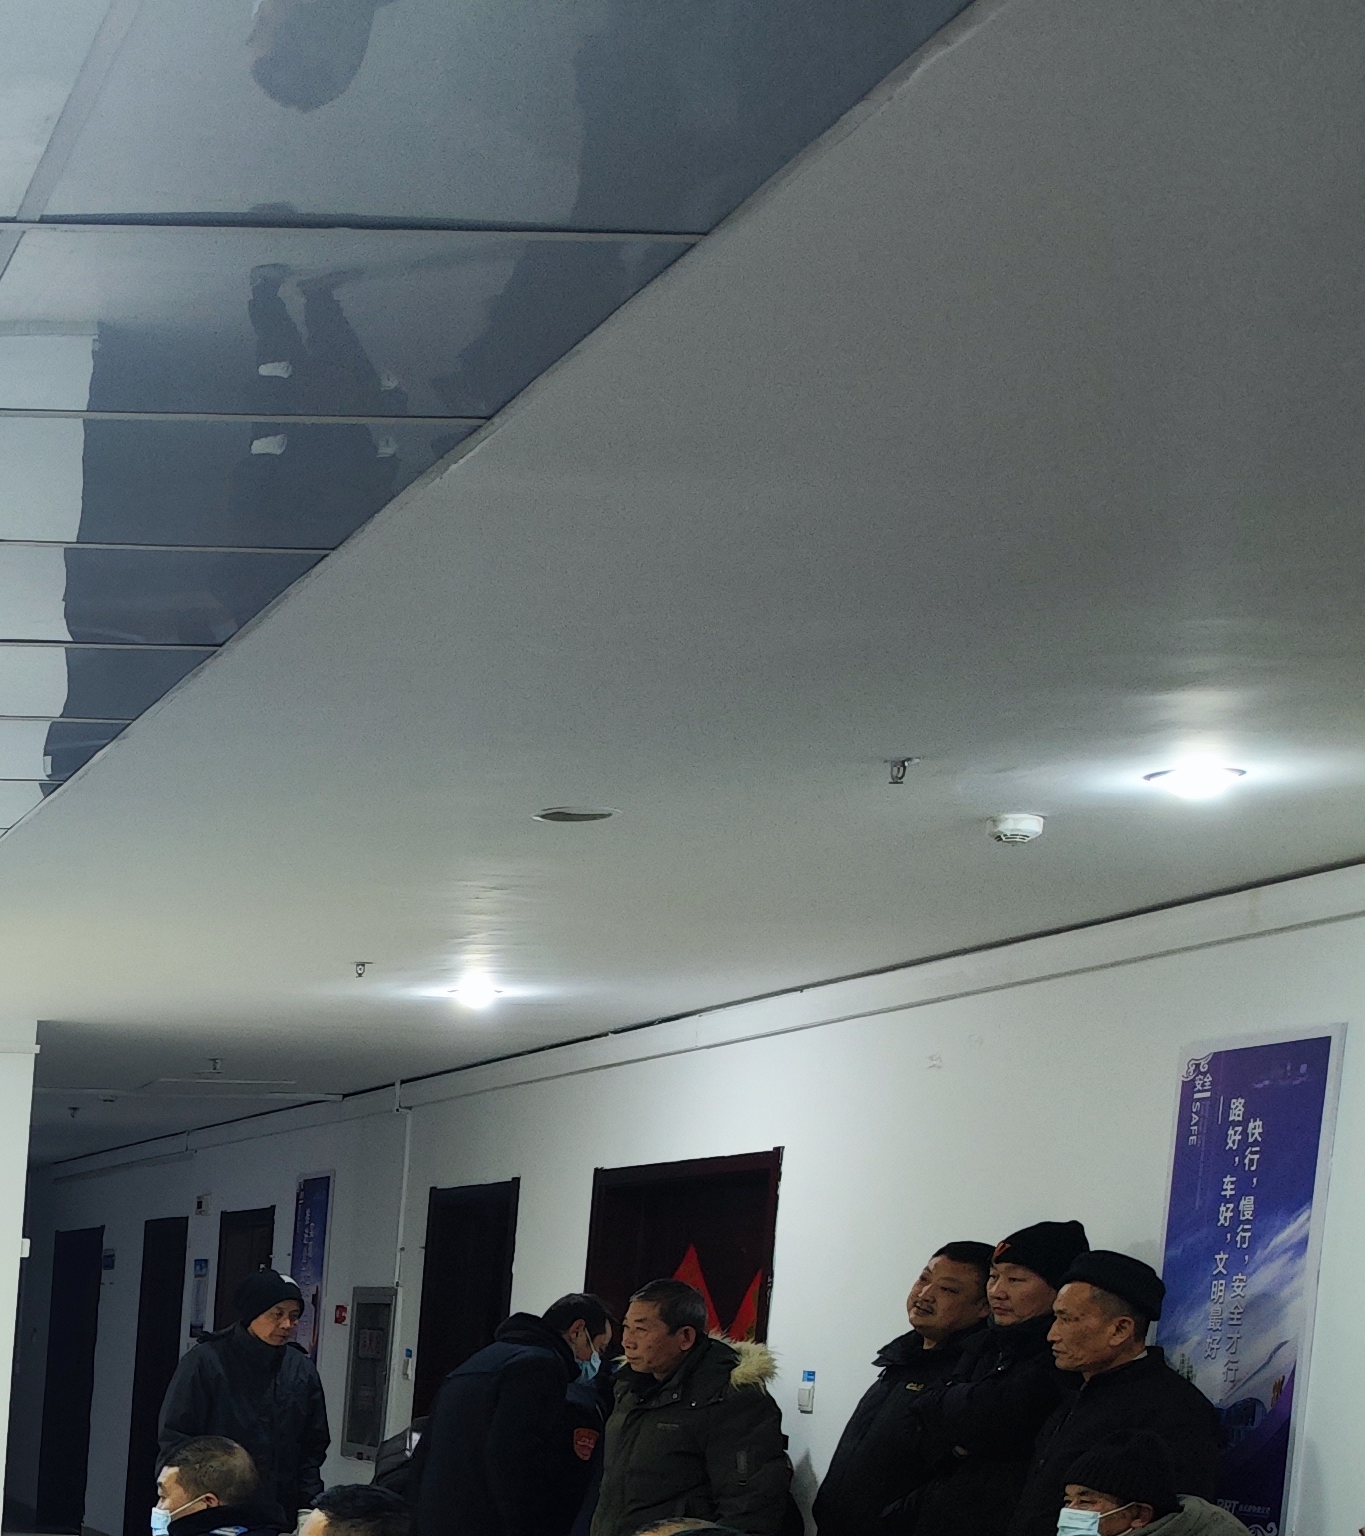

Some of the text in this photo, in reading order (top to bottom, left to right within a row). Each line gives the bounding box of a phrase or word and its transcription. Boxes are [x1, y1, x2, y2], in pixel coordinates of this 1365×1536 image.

[1188, 1101, 1201, 1146] SAFE
[1194, 1073, 1213, 1091] 安全
[1203, 1097, 1245, 1360] 路好，车好，文明最好
[1222, 1117, 1264, 1384] 快行，慢行，安全才行
